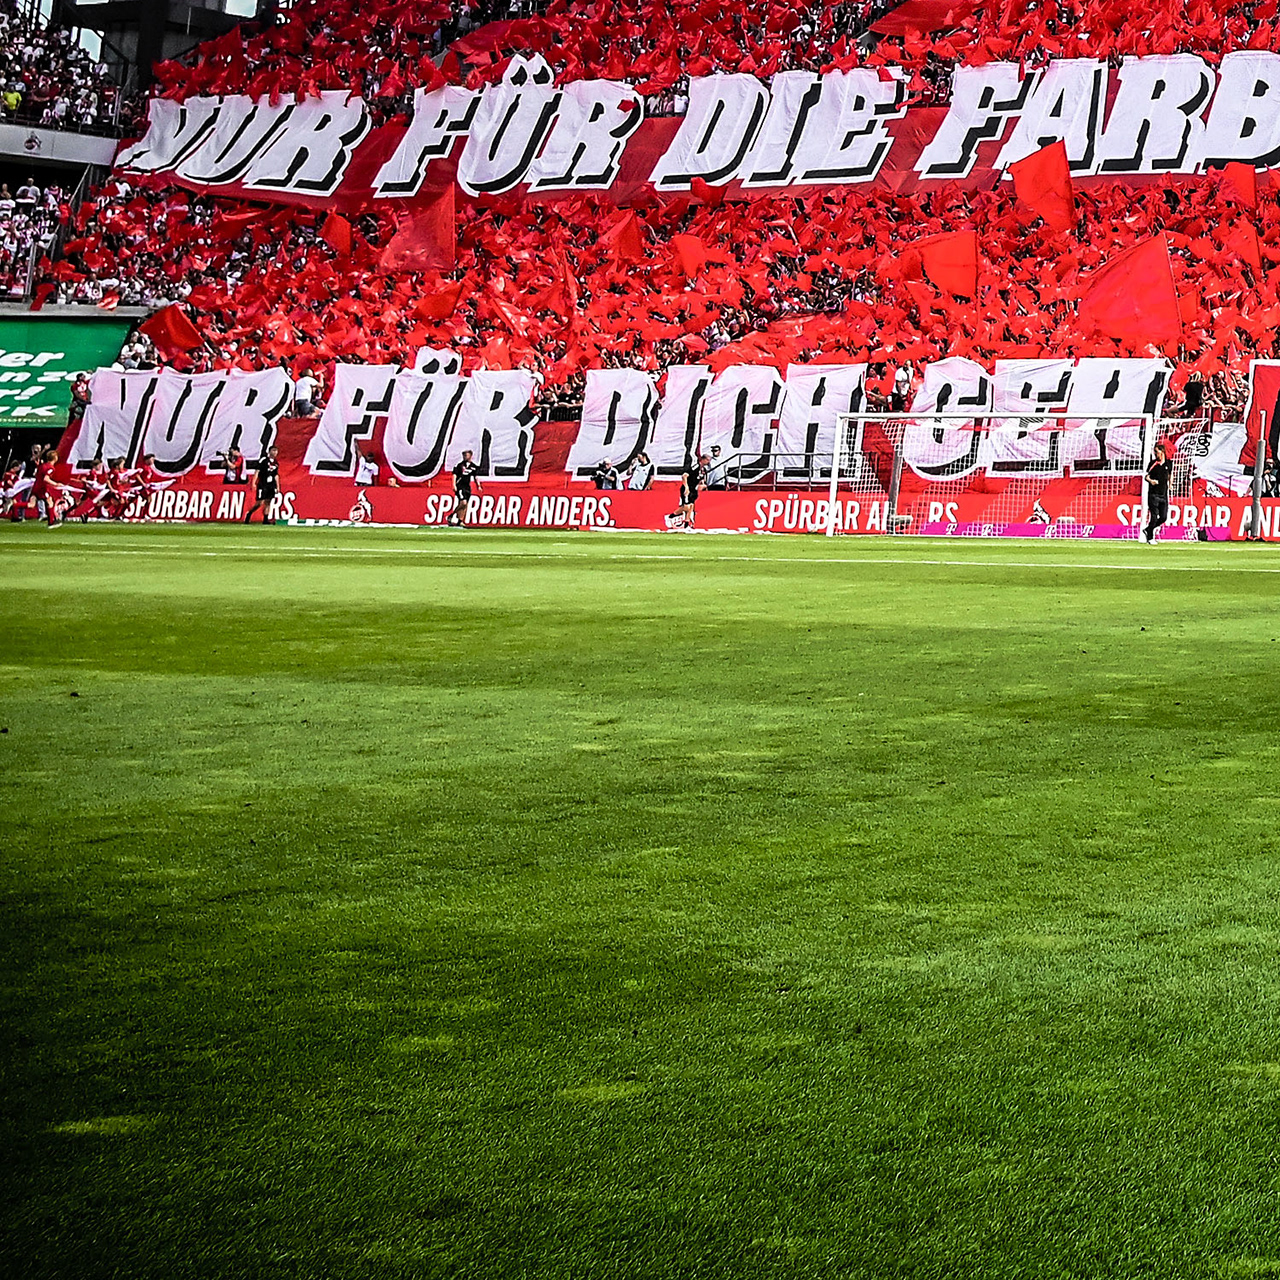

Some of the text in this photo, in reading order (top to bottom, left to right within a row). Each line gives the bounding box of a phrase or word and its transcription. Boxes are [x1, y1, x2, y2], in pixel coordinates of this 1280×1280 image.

[373, 53, 643, 198] FÜR
[648, 66, 909, 190] DIE
[69, 365, 296, 472] NUR
[304, 346, 537, 482] FÜR
[567, 362, 867, 483] DICH
[902, 356, 1174, 482] GEH
[525, 496, 617, 527] ANDERS.
